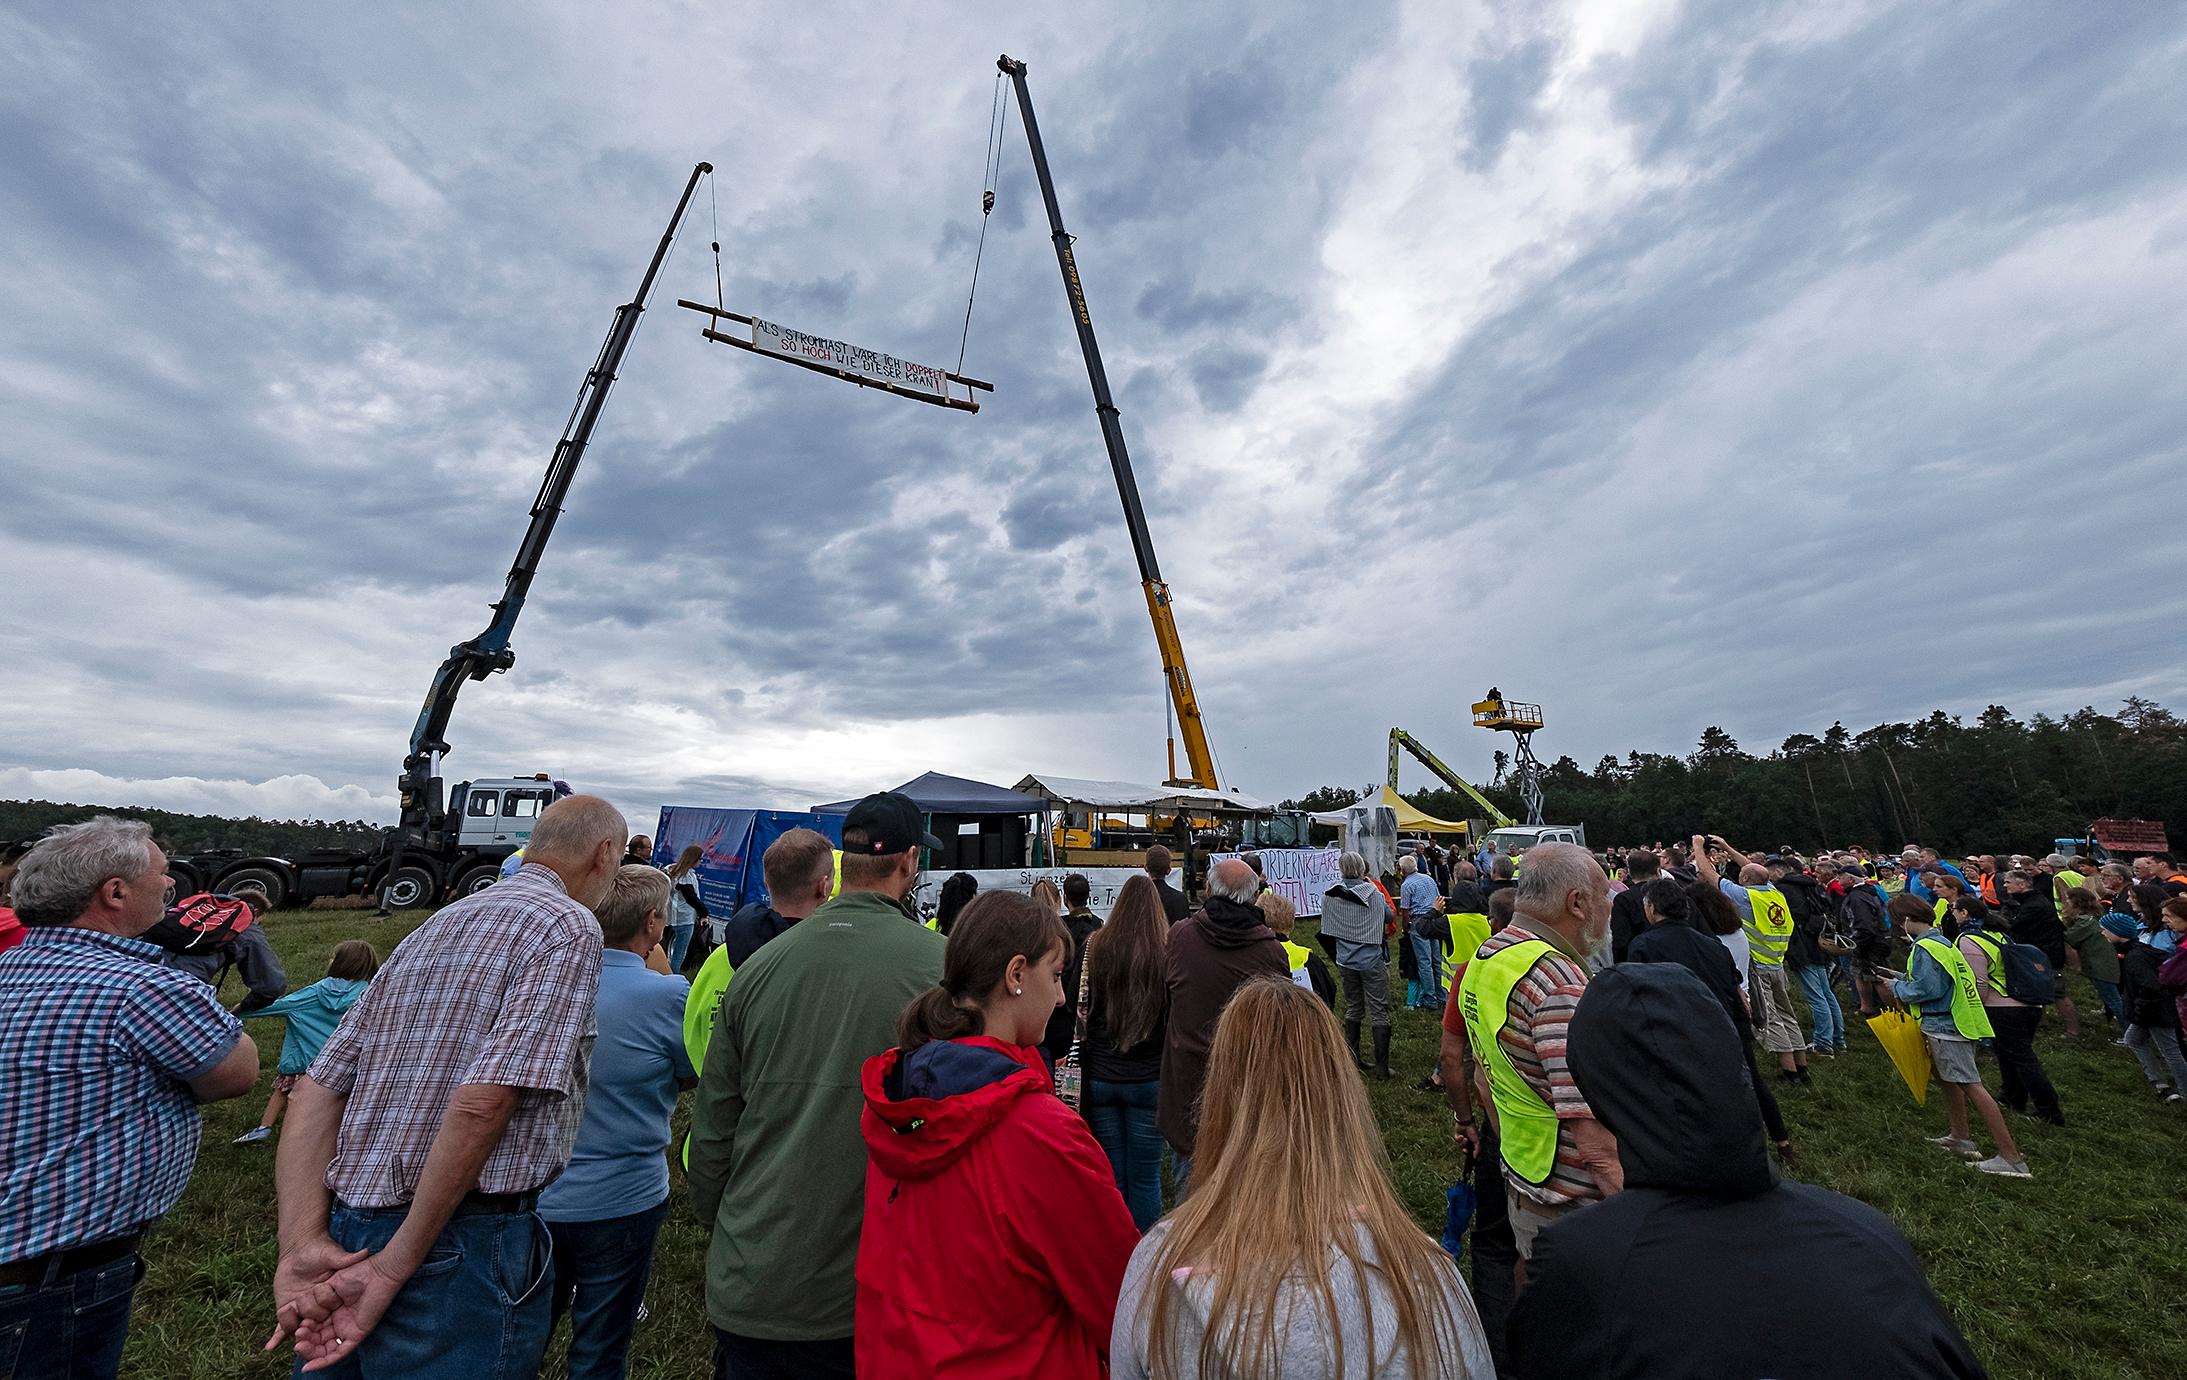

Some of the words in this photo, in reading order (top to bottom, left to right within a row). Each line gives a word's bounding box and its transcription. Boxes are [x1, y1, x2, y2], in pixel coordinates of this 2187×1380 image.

[756, 320, 779, 337] ALS
[785, 328, 848, 354] STROMMAST
[883, 353, 901, 369] ICH
[904, 361, 943, 381] DOPPELT
[780, 339, 797, 352] SO
[802, 344, 831, 361] HOCH
[835, 353, 857, 369] WIE
[862, 360, 902, 379] DIESER
[1254, 850, 1305, 880] ORDERN
